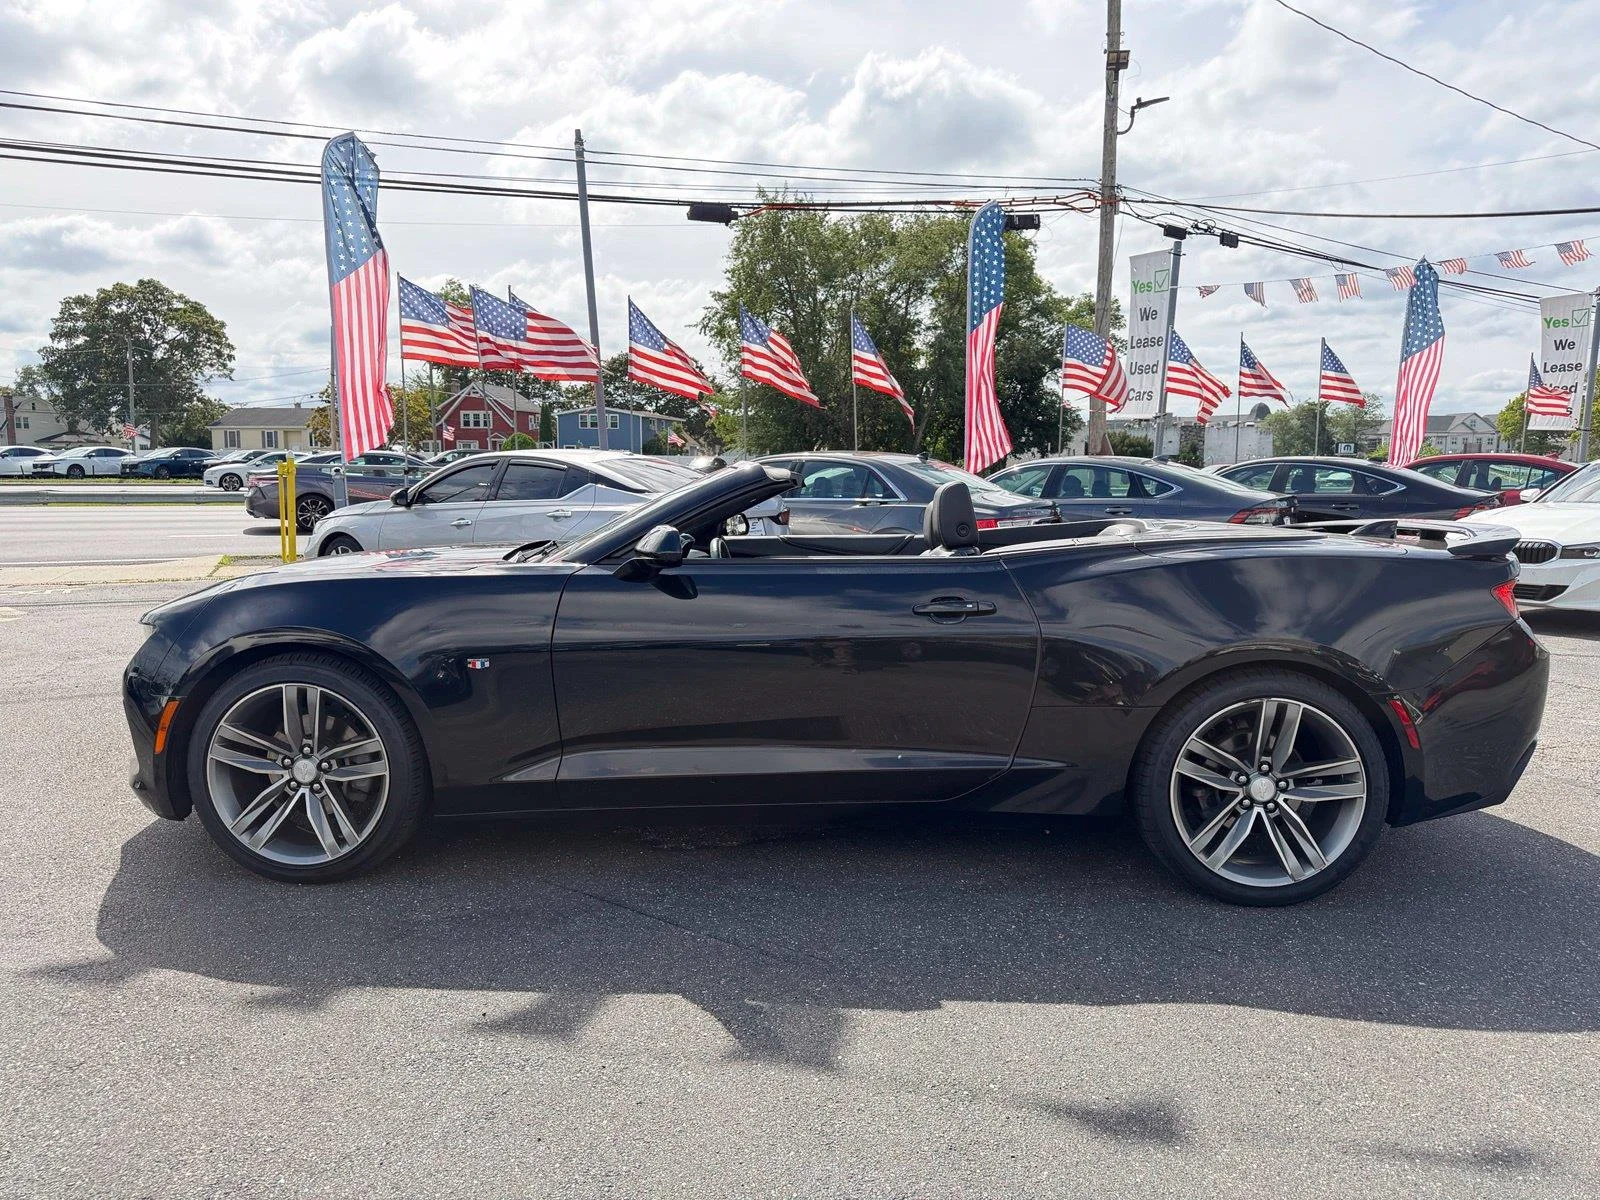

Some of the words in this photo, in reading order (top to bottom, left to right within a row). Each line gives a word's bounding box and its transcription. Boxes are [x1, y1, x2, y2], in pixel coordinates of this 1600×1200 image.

[1132, 280, 1153, 294] Yes
[1139, 307, 1158, 321] We
[1543, 316, 1570, 329] Yes
[1130, 335, 1164, 349] Lease
[1553, 338, 1576, 351] We
[1130, 359, 1159, 375] Used
[1543, 361, 1583, 373] Lease
[1127, 388, 1153, 401] Cars
